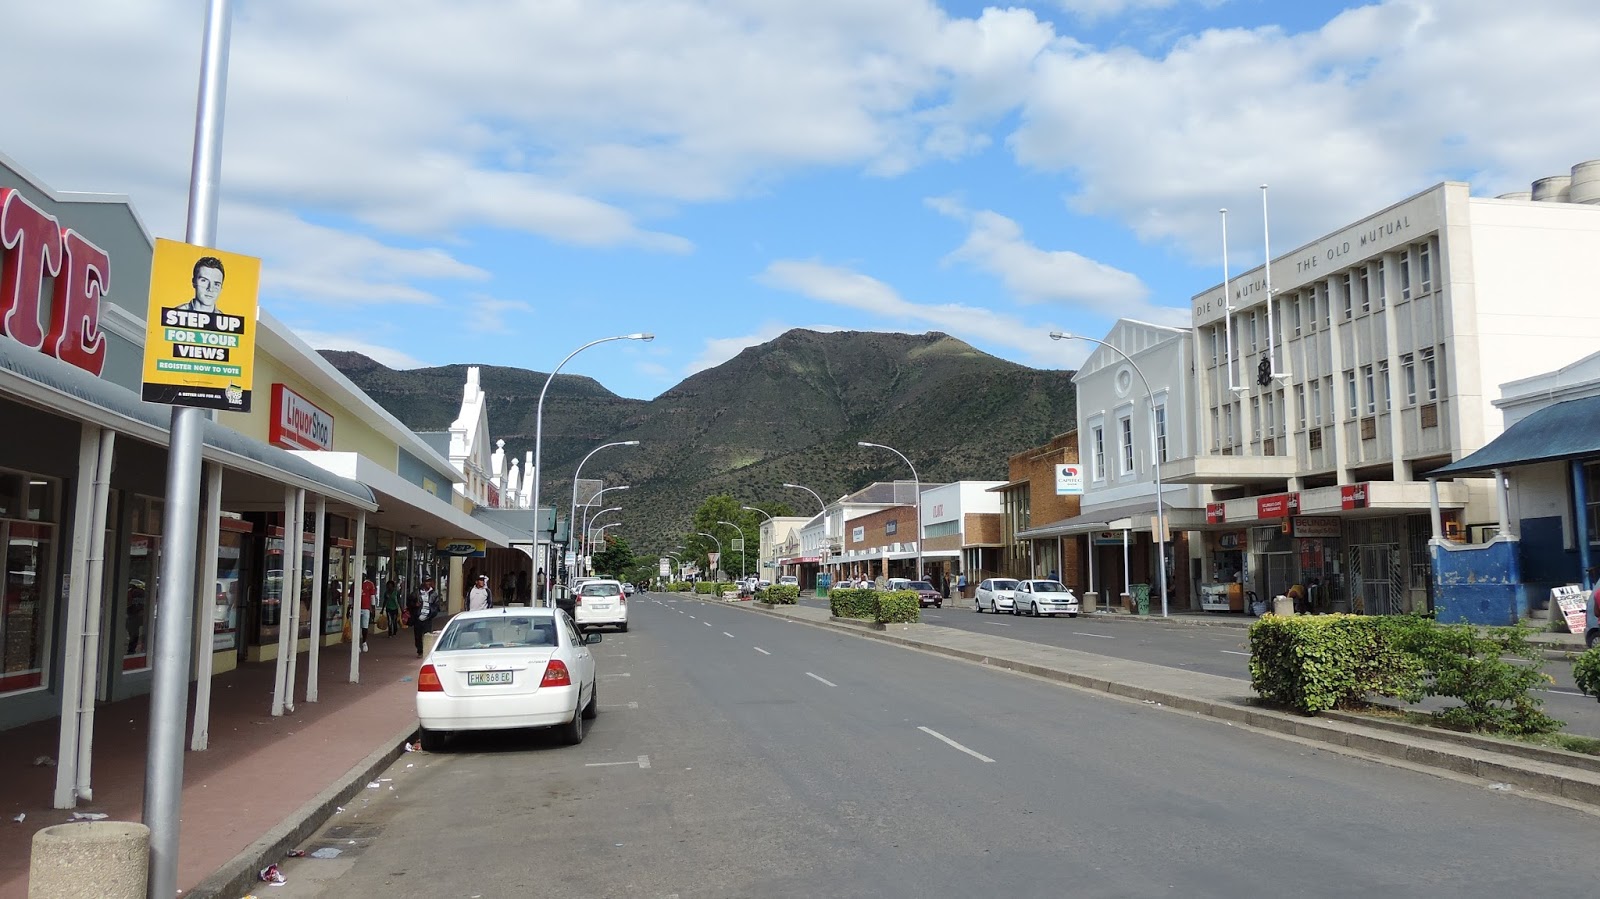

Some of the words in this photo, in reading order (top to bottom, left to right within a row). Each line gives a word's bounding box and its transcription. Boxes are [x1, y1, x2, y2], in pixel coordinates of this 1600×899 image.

[1296, 257, 1318, 273] THE
[1326, 242, 1350, 260] OLD
[1360, 216, 1411, 246] MUTUAL
[1196, 303, 1211, 317] DIE
[1236, 279, 1273, 298] MUTUA
[166, 310, 210, 328] STEP
[216, 315, 241, 332] UP
[167, 329, 196, 343] FOR
[200, 333, 237, 347] YOUR
[178, 345, 225, 360] VIEWS
[159, 361, 192, 371] REGISTER
[222, 367, 240, 375] VOTE
[1296, 518, 1338, 527] BELINDAS
[1222, 534, 1238, 546] MTN
[470, 674, 484, 683] FHK
[485, 673, 499, 682] 368
[501, 672, 510, 681] EC
